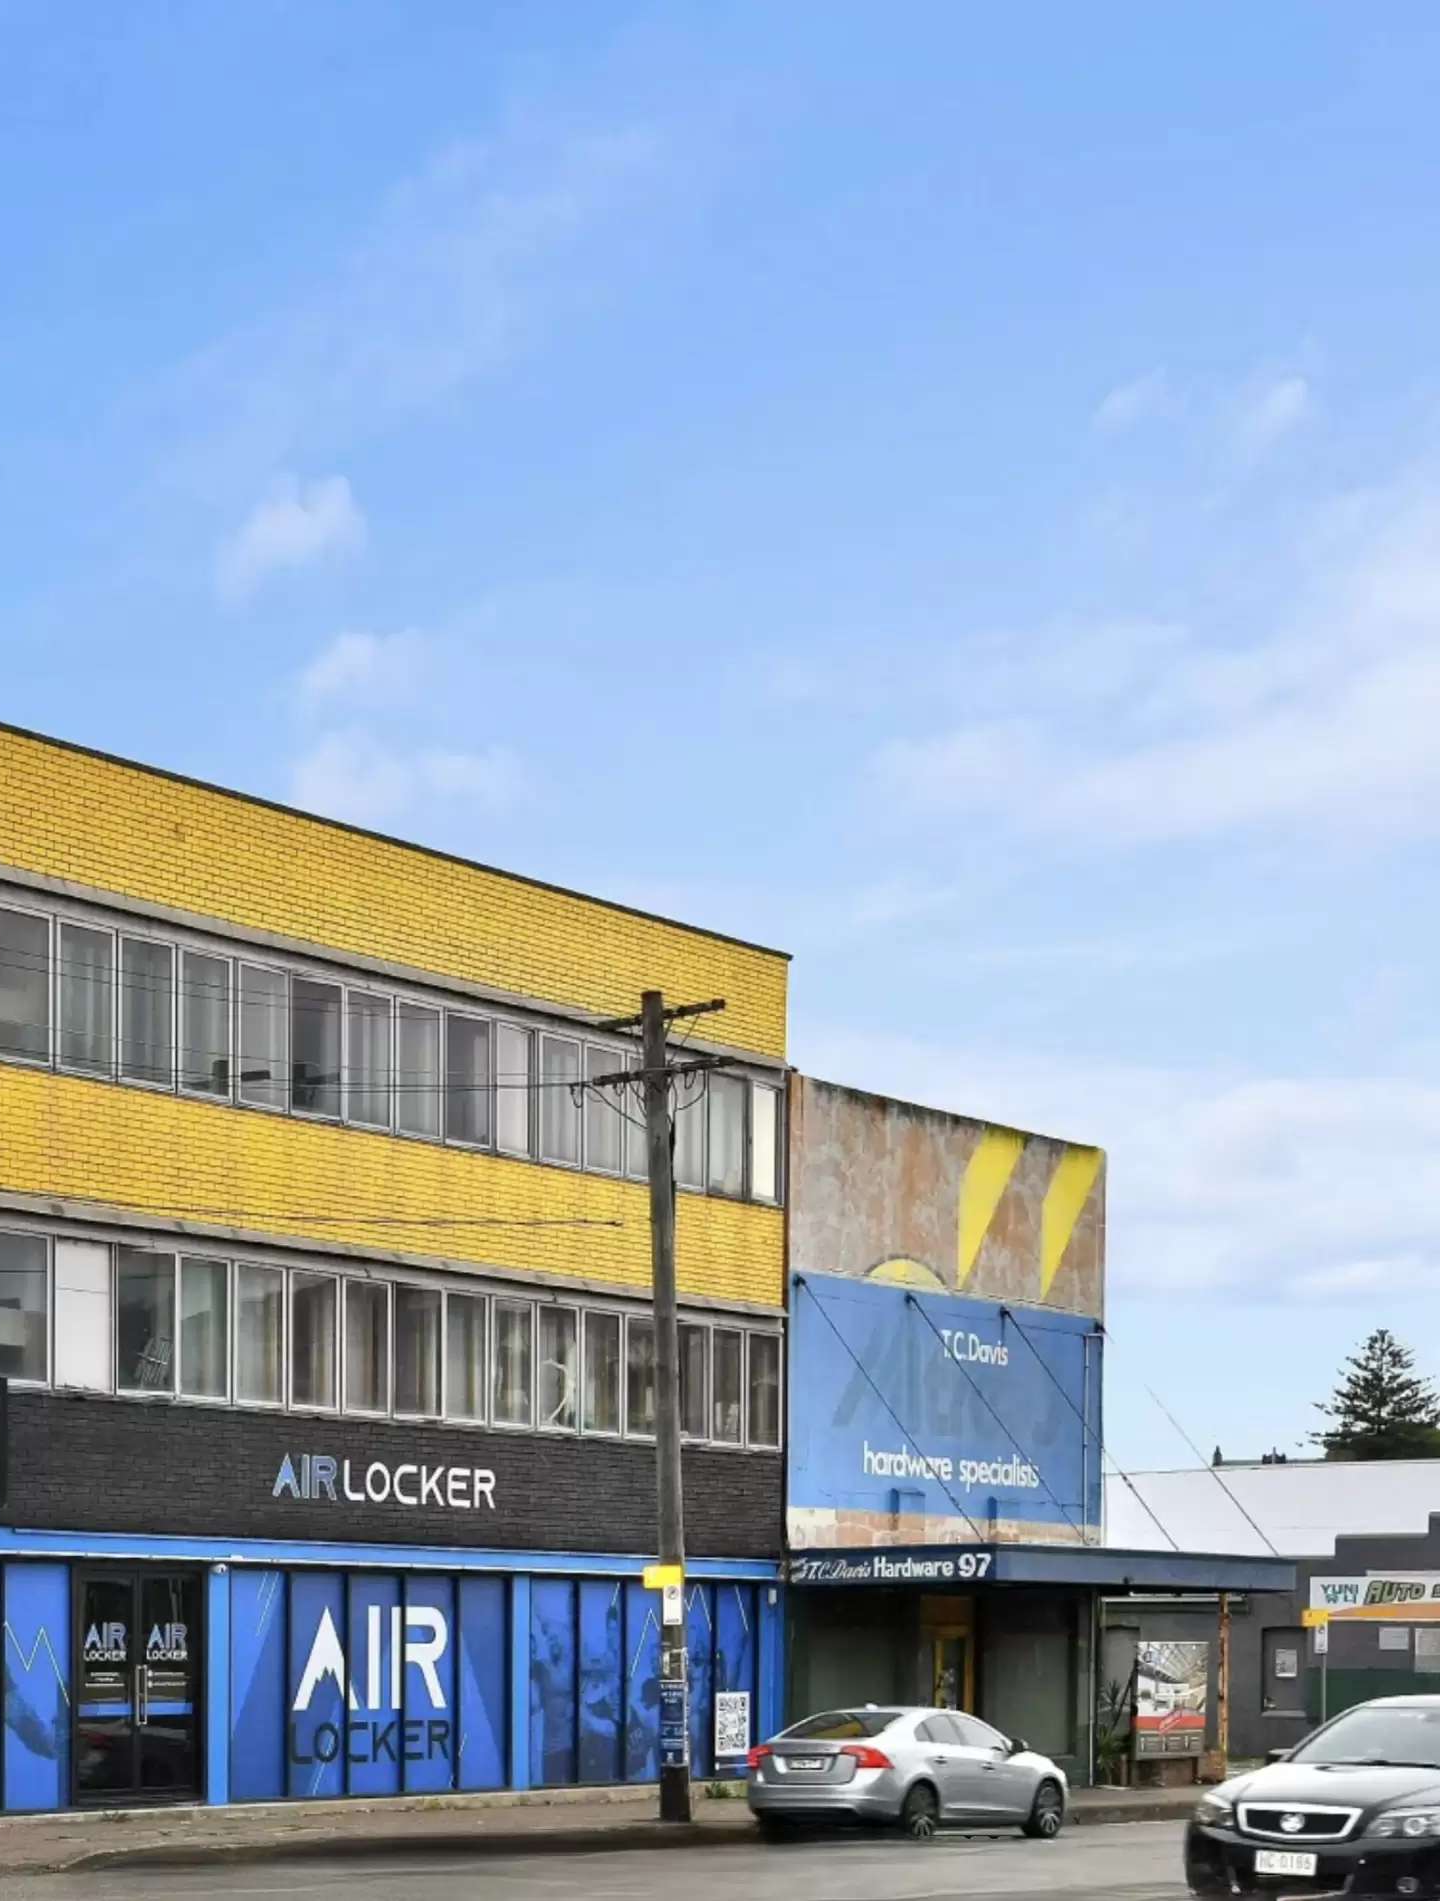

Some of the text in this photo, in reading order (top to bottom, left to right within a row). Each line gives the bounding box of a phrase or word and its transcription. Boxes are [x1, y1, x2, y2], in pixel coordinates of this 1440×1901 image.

[863, 1440, 1040, 1492] hardware specialists
[272, 1452, 497, 1509] AIR LOCKER
[873, 1556, 954, 1578] Hardware
[958, 1553, 992, 1577] 97
[84, 1622, 126, 1650] AIR
[147, 1623, 188, 1650] AIR
[83, 1650, 127, 1661] LOCKER
[146, 1650, 188, 1660] LOCKER
[292, 1605, 448, 1711] AIR
[291, 1719, 450, 1765] LOCKER
